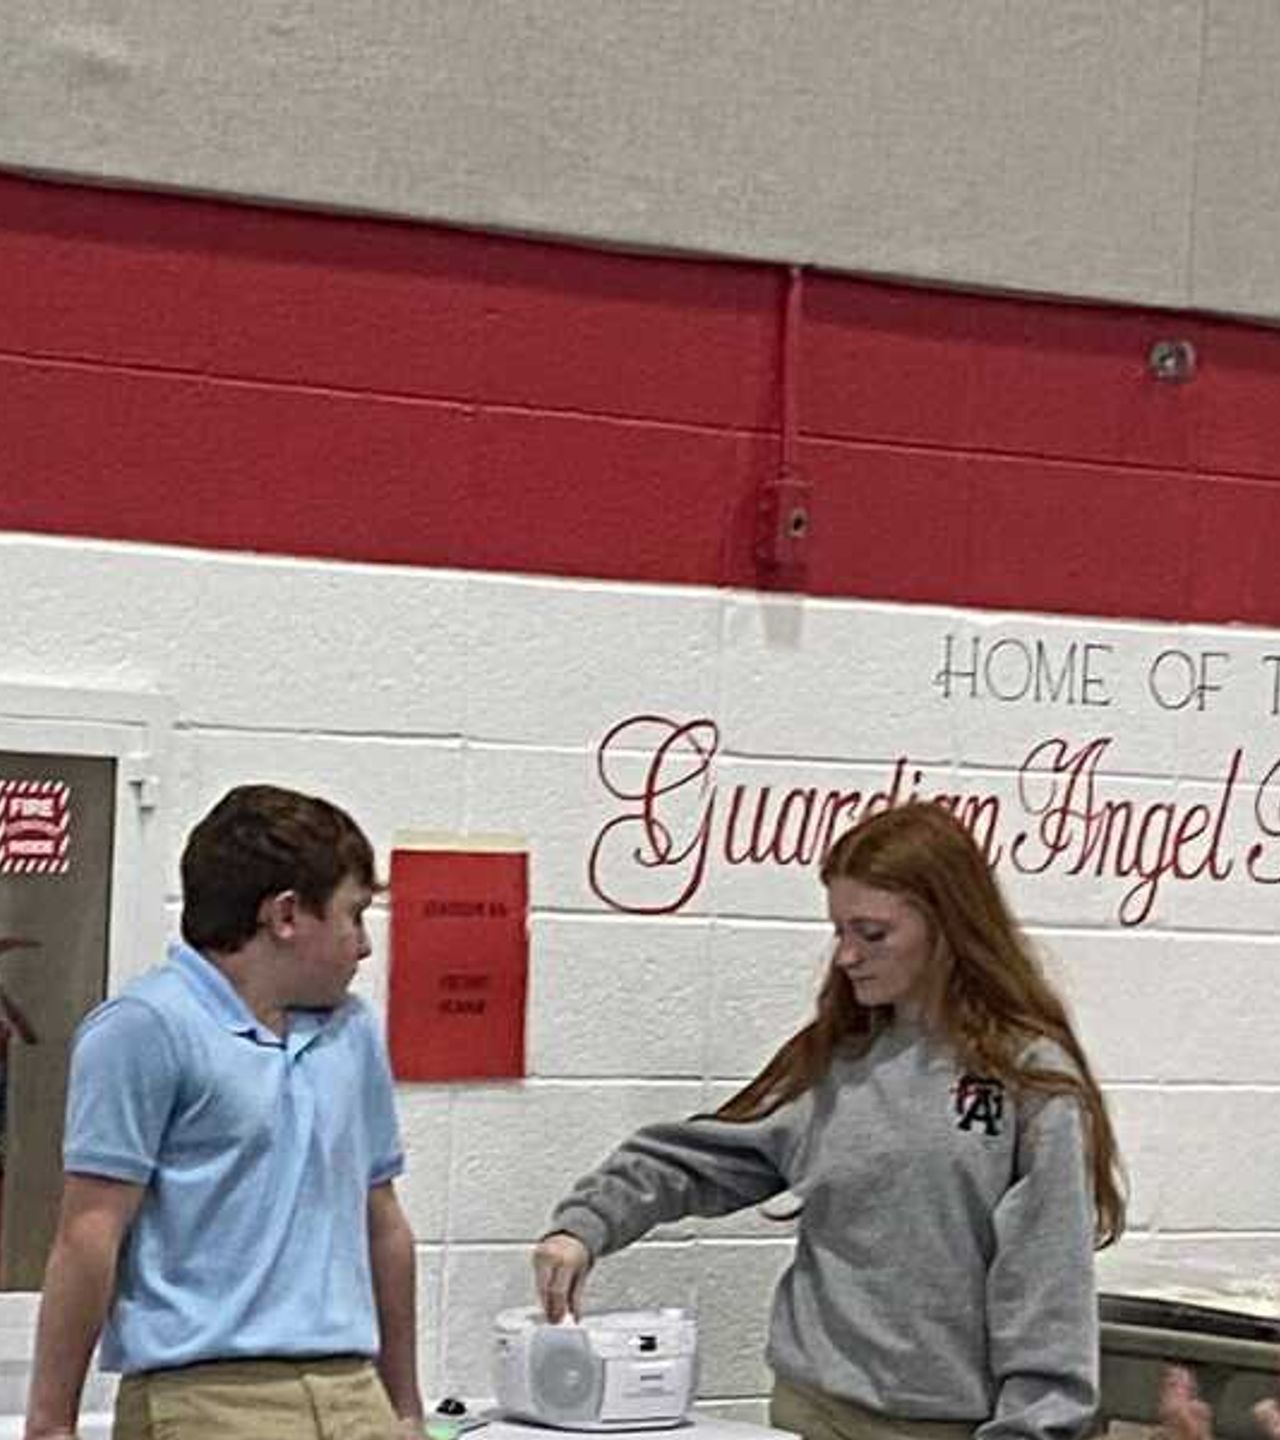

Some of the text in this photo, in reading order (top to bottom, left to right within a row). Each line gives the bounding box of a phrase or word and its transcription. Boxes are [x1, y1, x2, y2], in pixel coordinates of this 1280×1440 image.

[934, 634, 1114, 706] HOME
[1149, 650, 1230, 711] OF
[9, 798, 55, 817] FIRE
[1011, 738, 1243, 927] Angel
